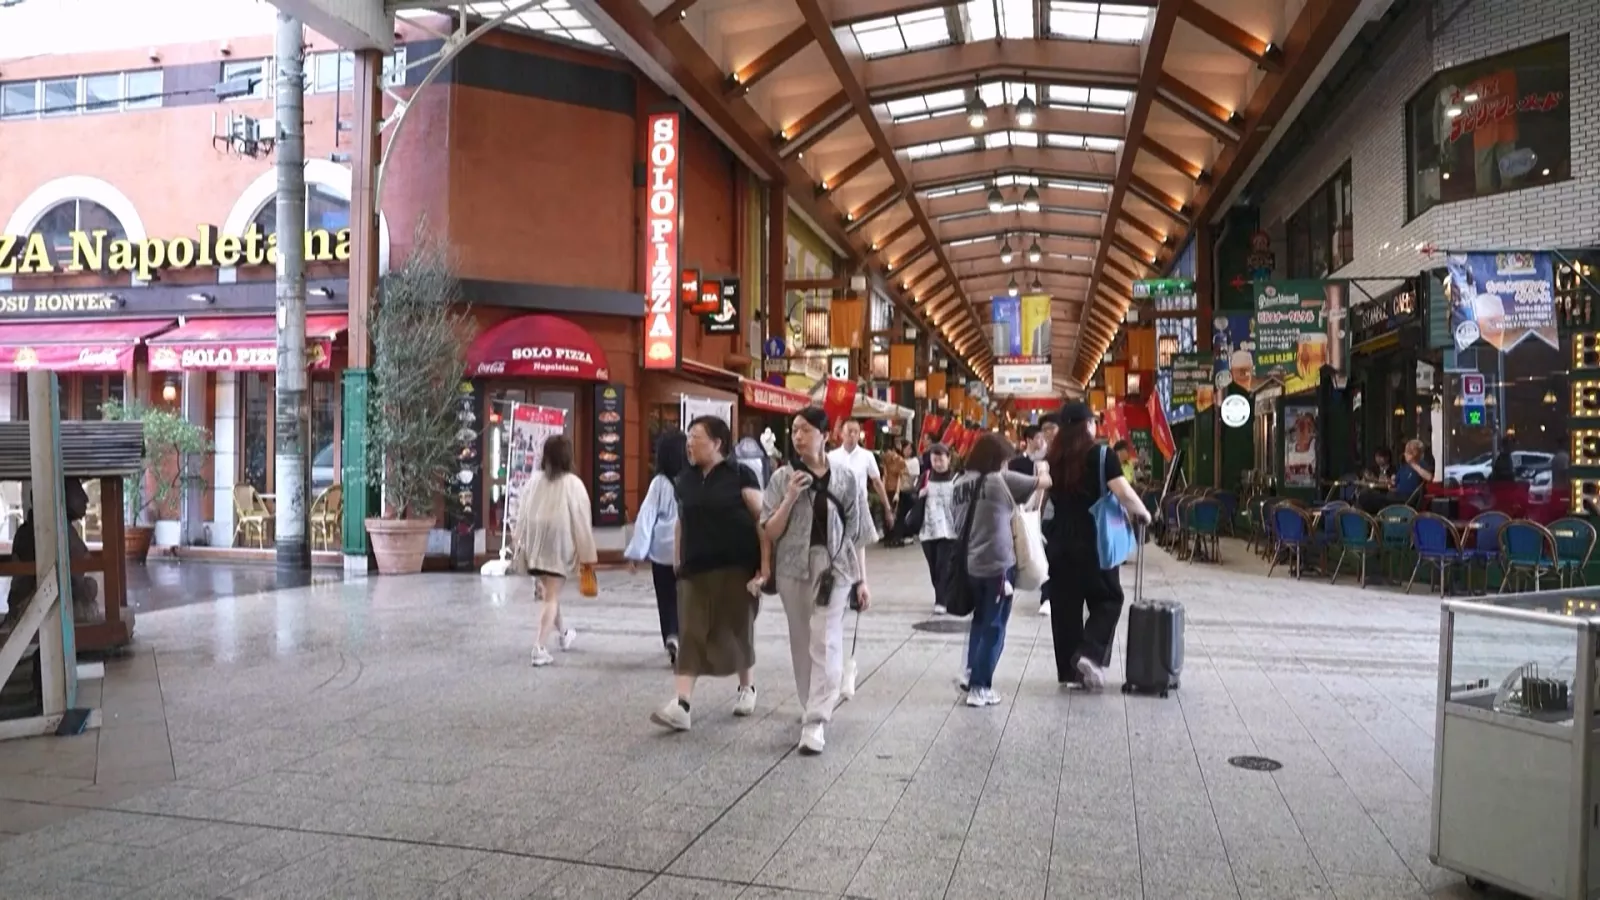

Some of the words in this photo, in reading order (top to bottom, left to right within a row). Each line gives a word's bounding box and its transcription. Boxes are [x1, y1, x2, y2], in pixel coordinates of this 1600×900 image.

[650, 118, 675, 216] SOLO
[649, 219, 674, 337] PIZZA
[181, 347, 233, 366] SOLO
[512, 347, 553, 360] SOLO
[555, 347, 593, 364] PIZZA
